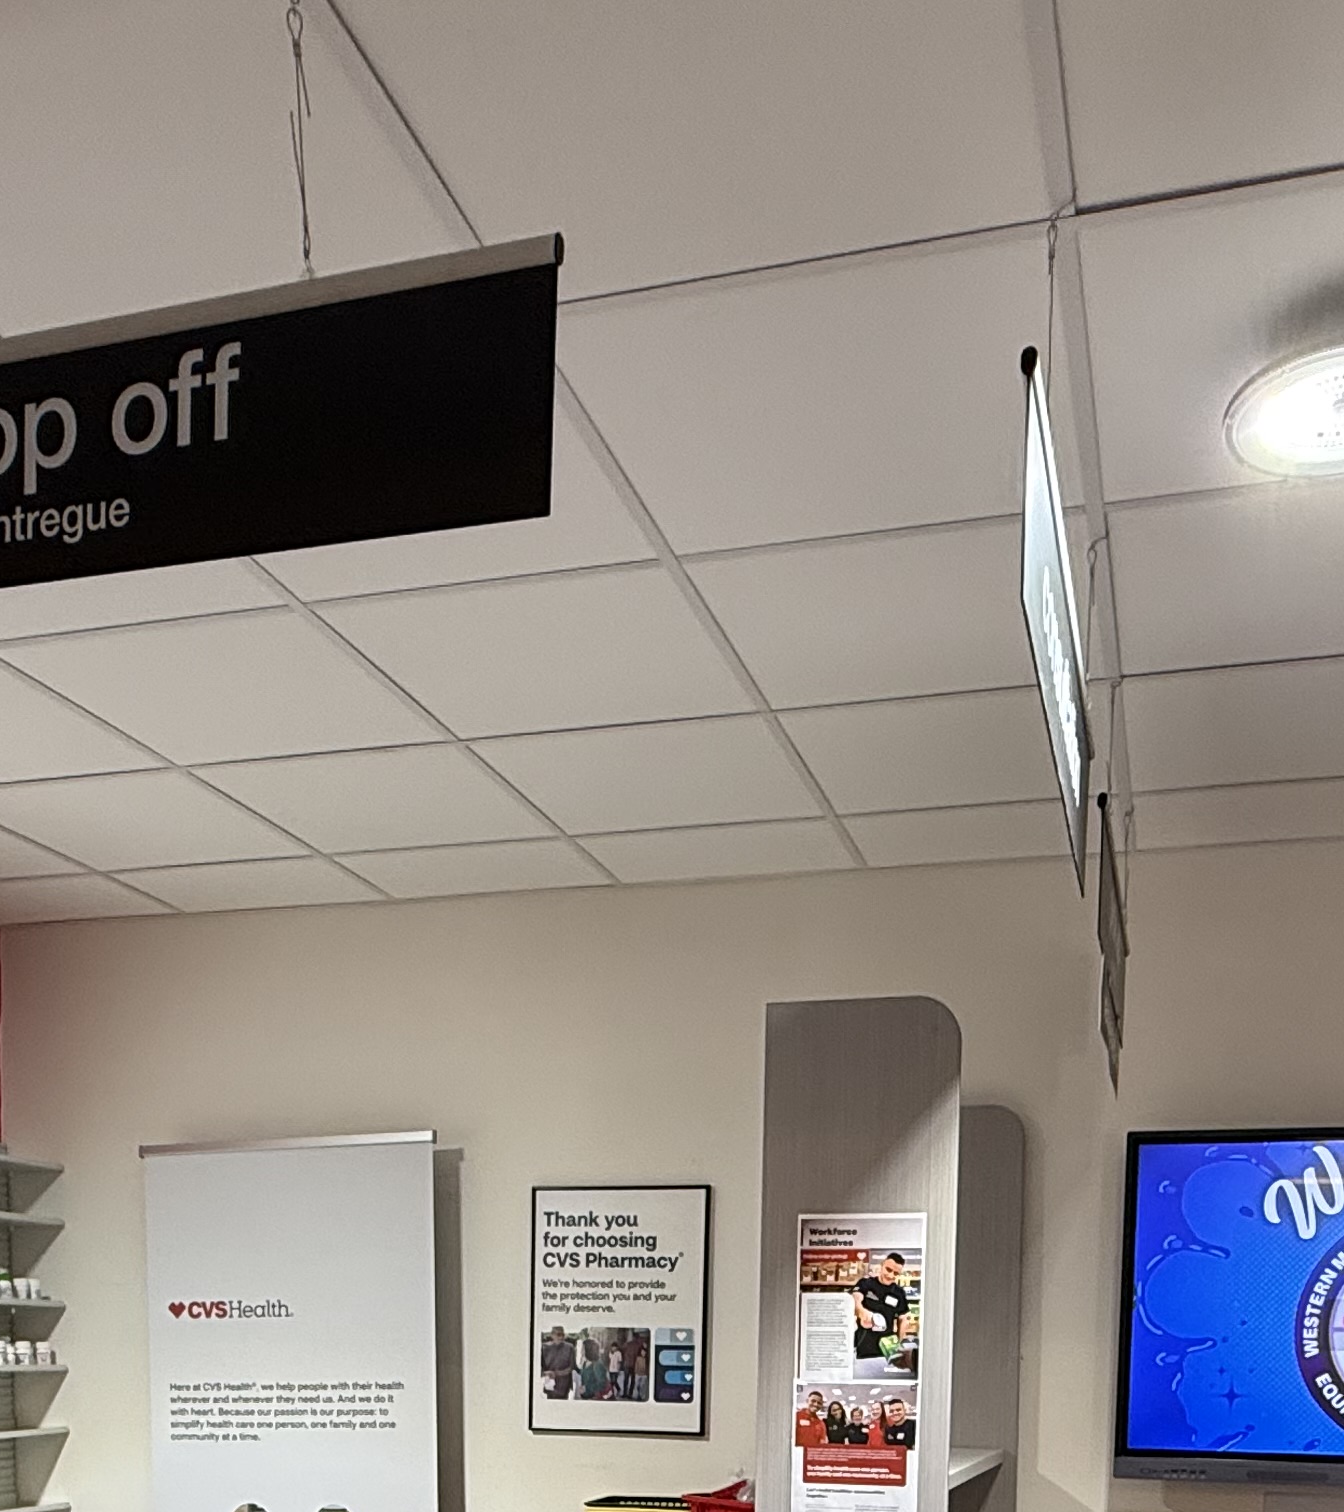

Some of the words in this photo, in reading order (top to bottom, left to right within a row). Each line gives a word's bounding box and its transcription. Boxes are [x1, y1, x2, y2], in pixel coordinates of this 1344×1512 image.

[112, 342, 241, 455] off
[544, 1211, 600, 1228] Thank
[604, 1215, 638, 1231] you
[543, 1232, 569, 1248] for
[573, 1232, 657, 1251] choosing
[809, 1238, 853, 1246] Initiatives
[542, 1253, 581, 1268] CVS
[542, 1279, 570, 1289] We're
[573, 1279, 613, 1289] honored
[616, 1280, 626, 1289] to
[628, 1279, 666, 1291] provide
[542, 1291, 558, 1301] the
[560, 1291, 610, 1303] protection
[612, 1293, 631, 1303] you
[633, 1292, 652, 1302] and
[654, 1294, 677, 1303] your
[542, 1302, 571, 1314] family
[573, 1303, 615, 1313] deserve.
[1304, 1268, 1338, 1358] WESTERN
[203, 1383, 221, 1391] CVS
[276, 1383, 295, 1392] help
[298, 1383, 328, 1392] people
[331, 1382, 349, 1390] with
[352, 1382, 372, 1390] their
[170, 1395, 210, 1403] wherever
[232, 1395, 274, 1403] whenever
[276, 1395, 295, 1405] they
[298, 1395, 320, 1403] need
[338, 1395, 356, 1403] And
[374, 1395, 386, 1403] do
[219, 1407, 255, 1415] Because
[274, 1409, 308, 1417] passion
[171, 1420, 204, 1430] simplify
[207, 1420, 233, 1428] health
[329, 1420, 357, 1430] family
[359, 1420, 376, 1428] and
[171, 1433, 219, 1442] community
